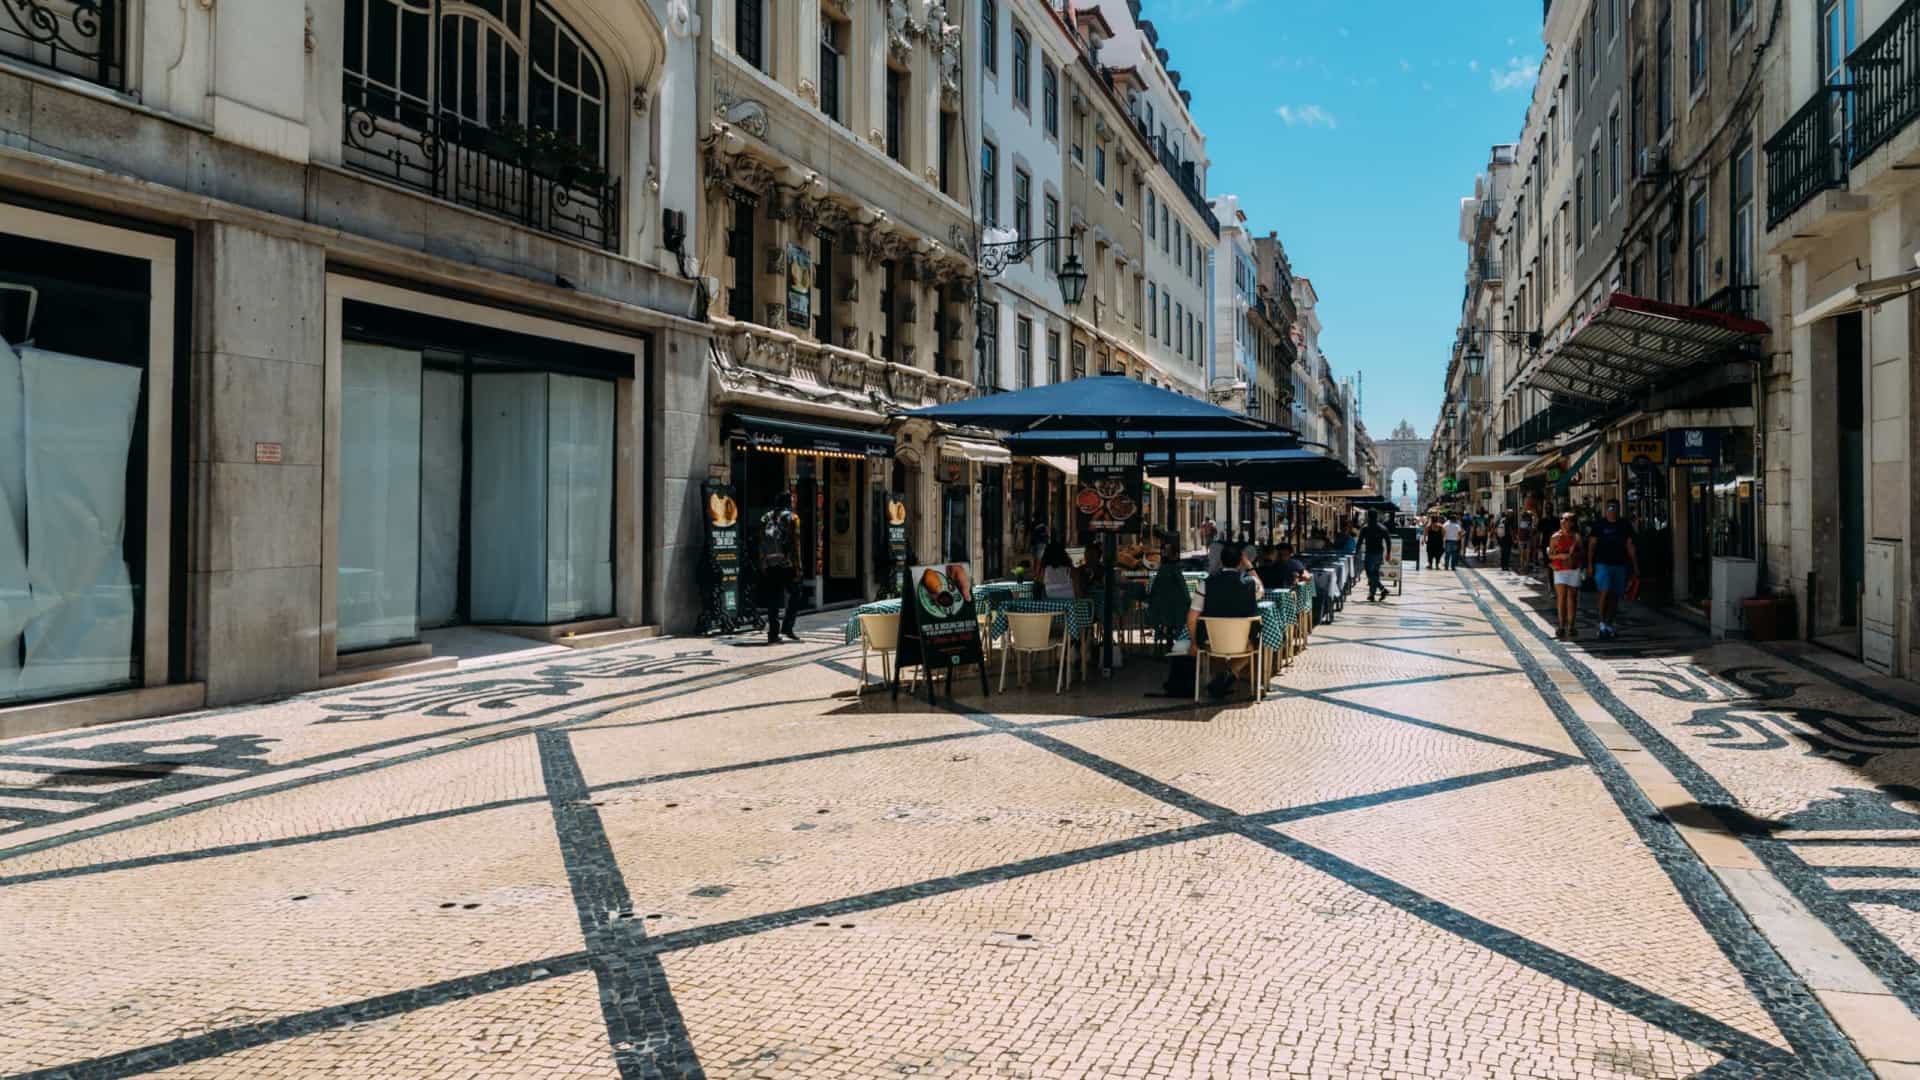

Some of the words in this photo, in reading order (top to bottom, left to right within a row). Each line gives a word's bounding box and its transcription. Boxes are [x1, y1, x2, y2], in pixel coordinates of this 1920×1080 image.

[1627, 443, 1657, 453] ATM
[1080, 452, 1086, 466] O
[1087, 452, 1114, 466] MELHOR
[1115, 452, 1138, 466] ARROZ
